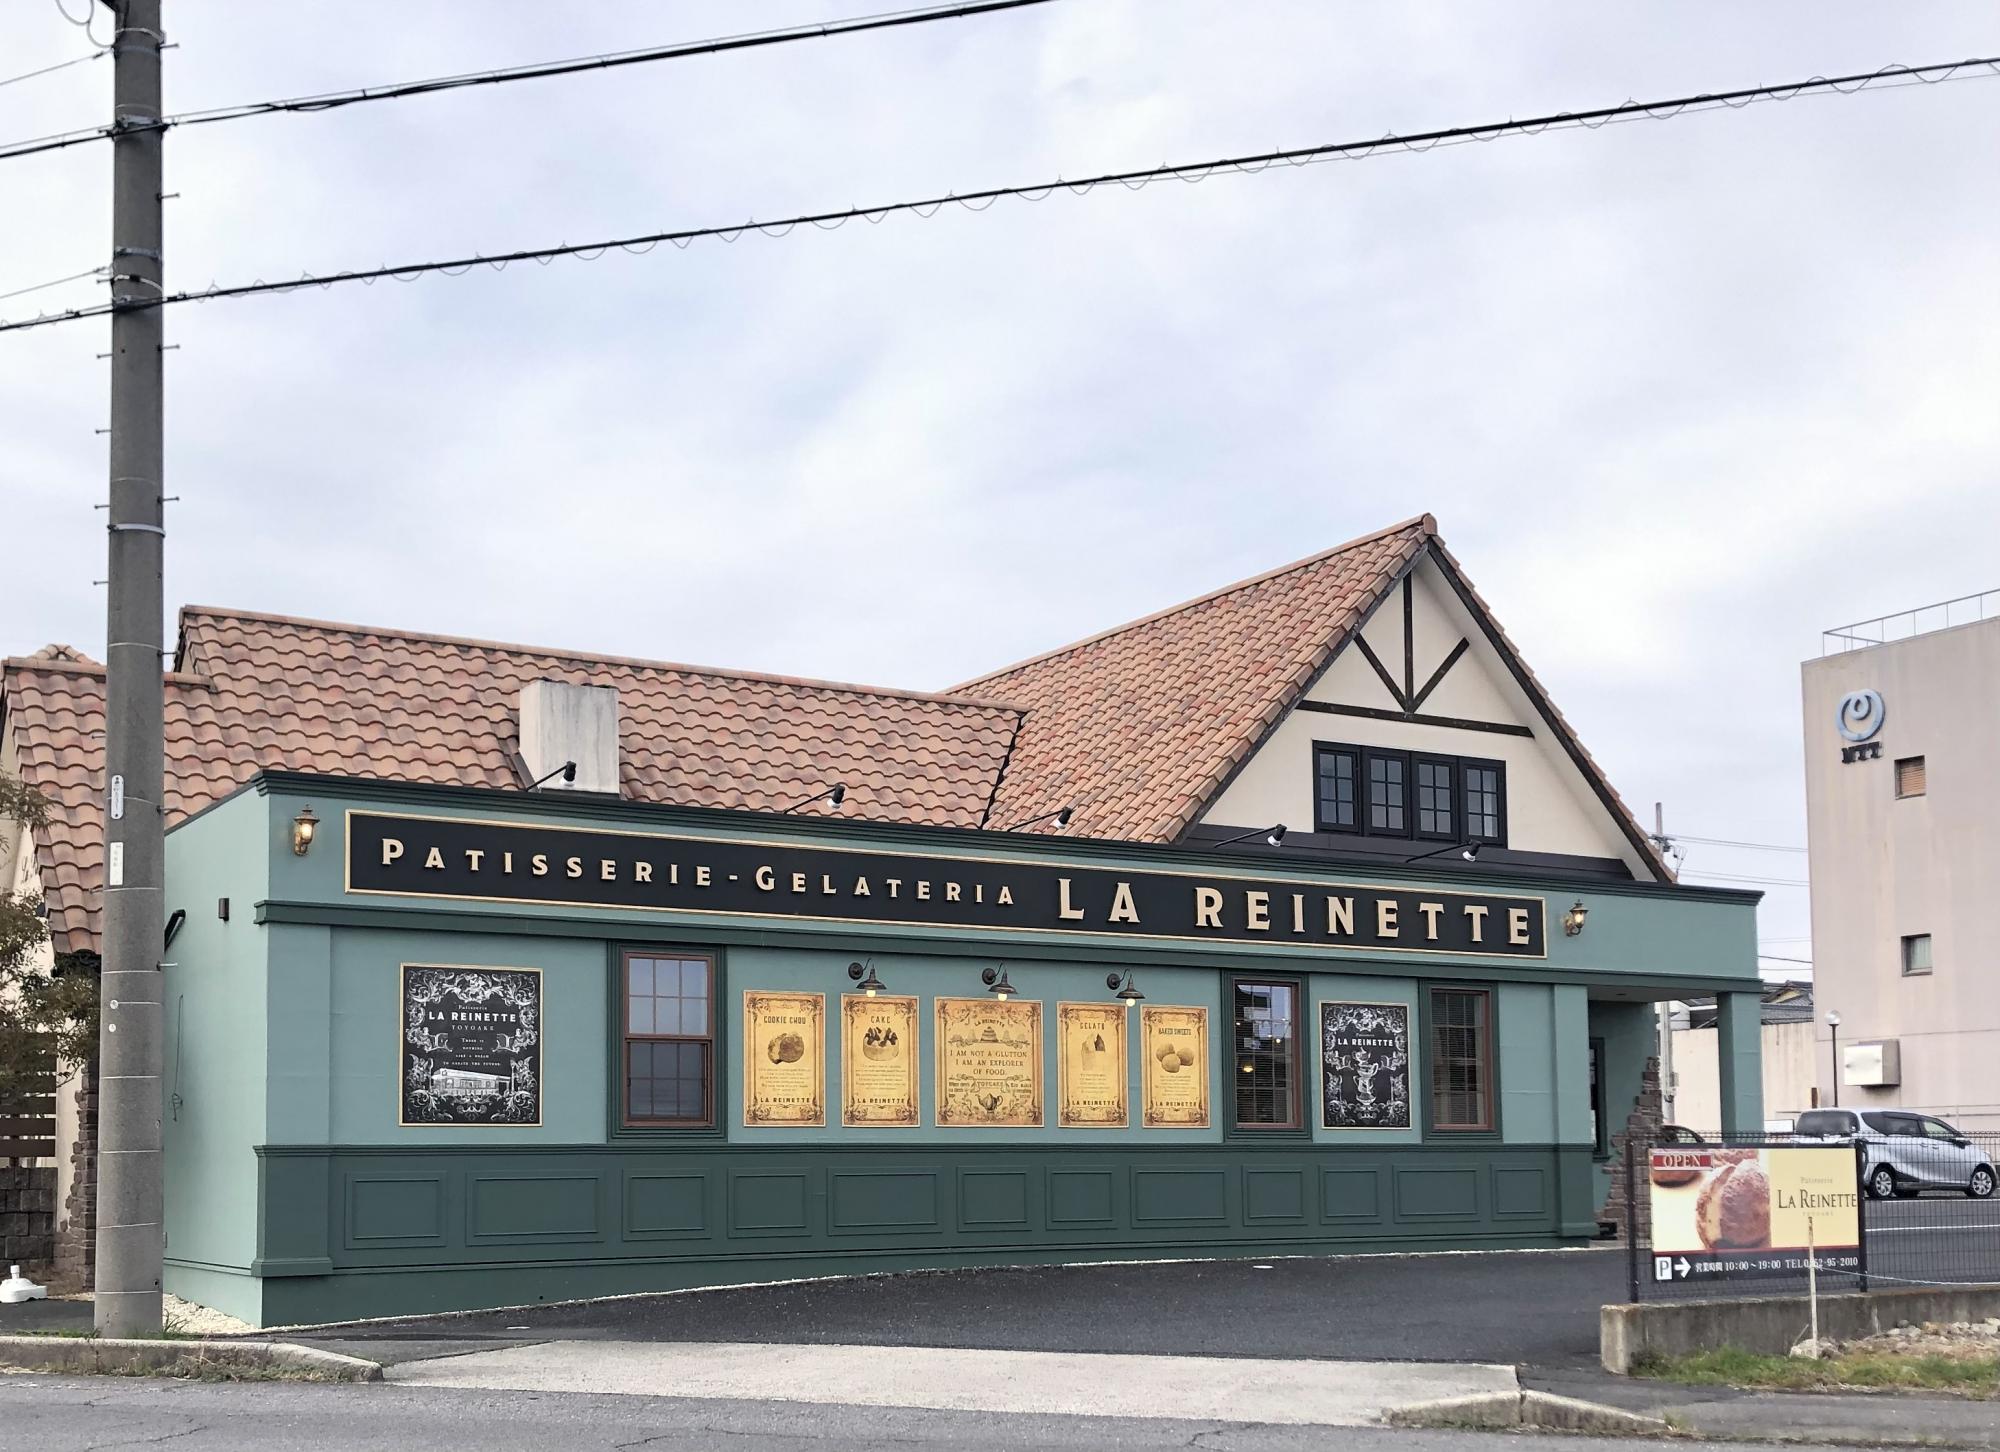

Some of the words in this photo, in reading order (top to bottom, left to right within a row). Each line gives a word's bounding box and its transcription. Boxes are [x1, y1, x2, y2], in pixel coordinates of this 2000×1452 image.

[1841, 741, 1882, 764] NTT
[1058, 878, 1141, 924] LA
[1195, 886, 1531, 945] REINETTE
[428, 1011, 445, 1020] LA
[451, 1012, 517, 1022] REINETTE
[763, 1015, 787, 1024] COOKIE
[870, 1015, 891, 1024] CAKE
[1080, 1022, 1105, 1030] GELATO
[1337, 1038, 1348, 1046] LA
[1352, 1038, 1394, 1047] REINETTE
[1662, 1154, 1703, 1168] OPEN
[1803, 1256, 1859, 1269] 02-95-2010
